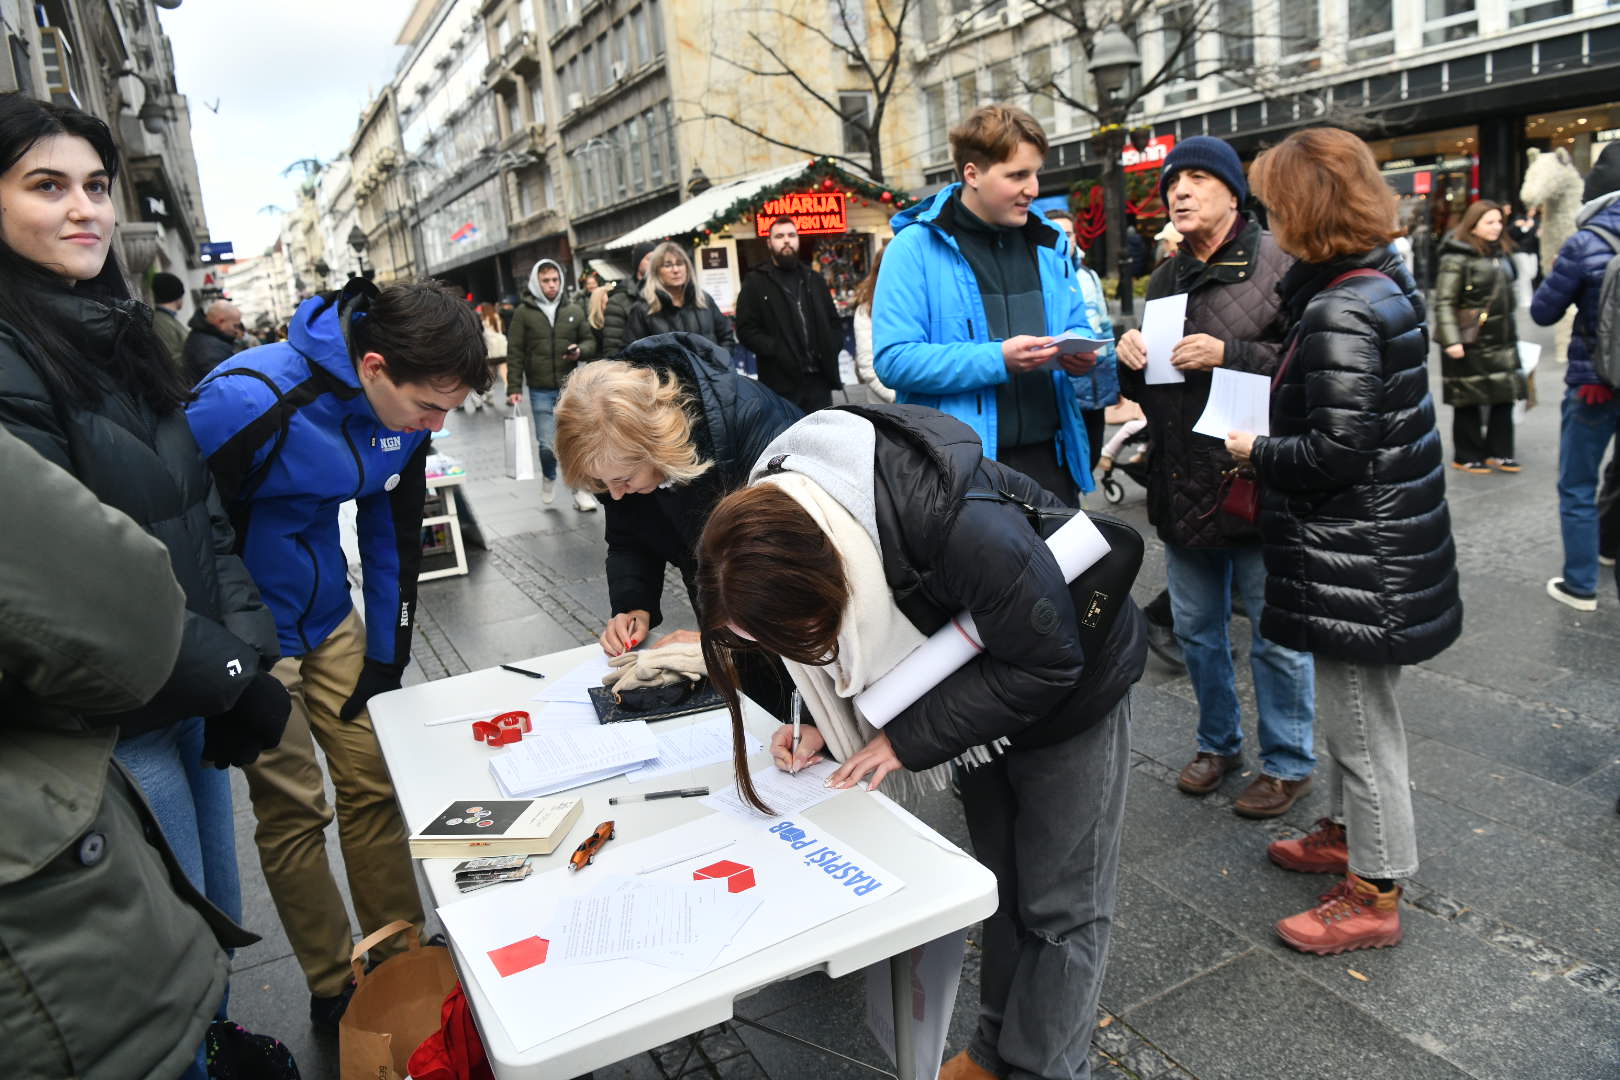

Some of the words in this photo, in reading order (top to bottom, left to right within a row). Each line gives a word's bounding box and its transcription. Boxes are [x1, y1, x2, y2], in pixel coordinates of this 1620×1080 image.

[763, 196, 840, 215] VINARIJA
[821, 214, 843, 229] VAL
[380, 436, 401, 449] NGN
[803, 846, 882, 896] RASPIŠI
